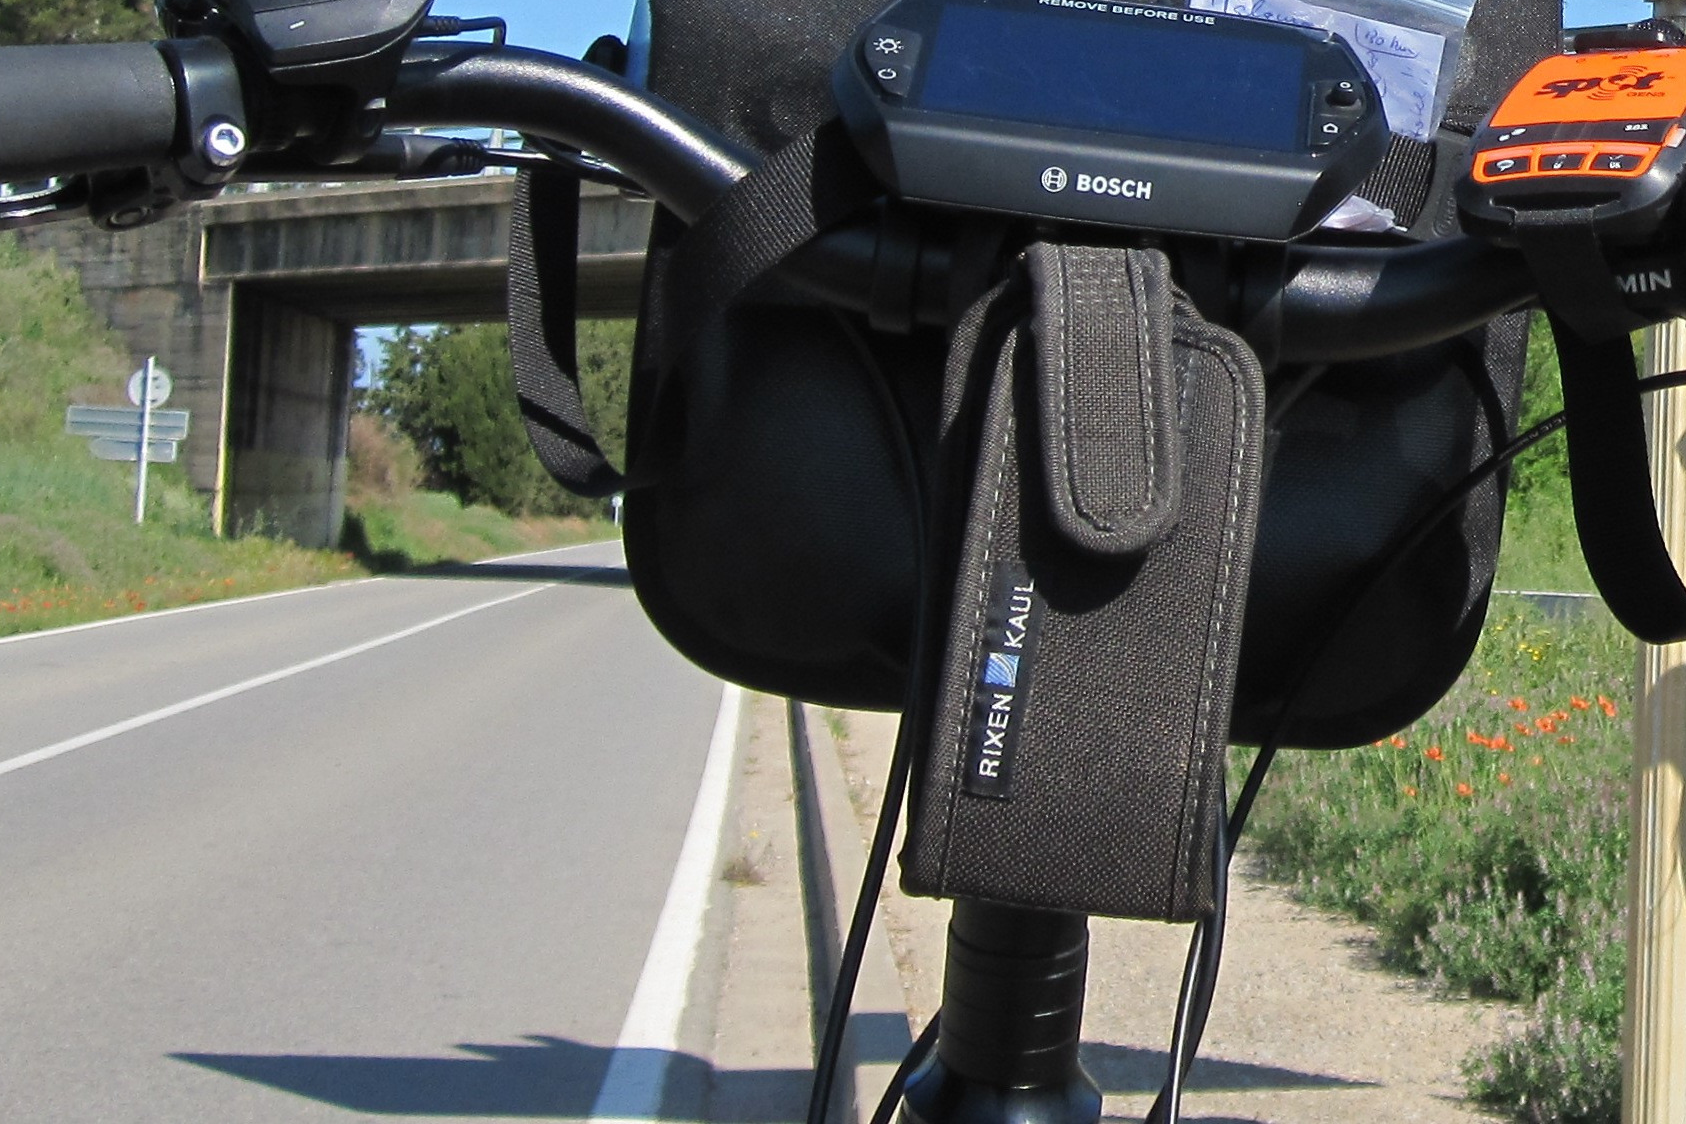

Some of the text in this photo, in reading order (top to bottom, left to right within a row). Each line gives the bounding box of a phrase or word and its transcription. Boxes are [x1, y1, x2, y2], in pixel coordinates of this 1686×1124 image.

[1112, 5, 1178, 21] BEFORE
[1183, 13, 1216, 25] USE
[1076, 173, 1152, 200] BOSCH
[1614, 268, 1673, 294] MIN
[978, 578, 1036, 778] RIXEN KAUL
